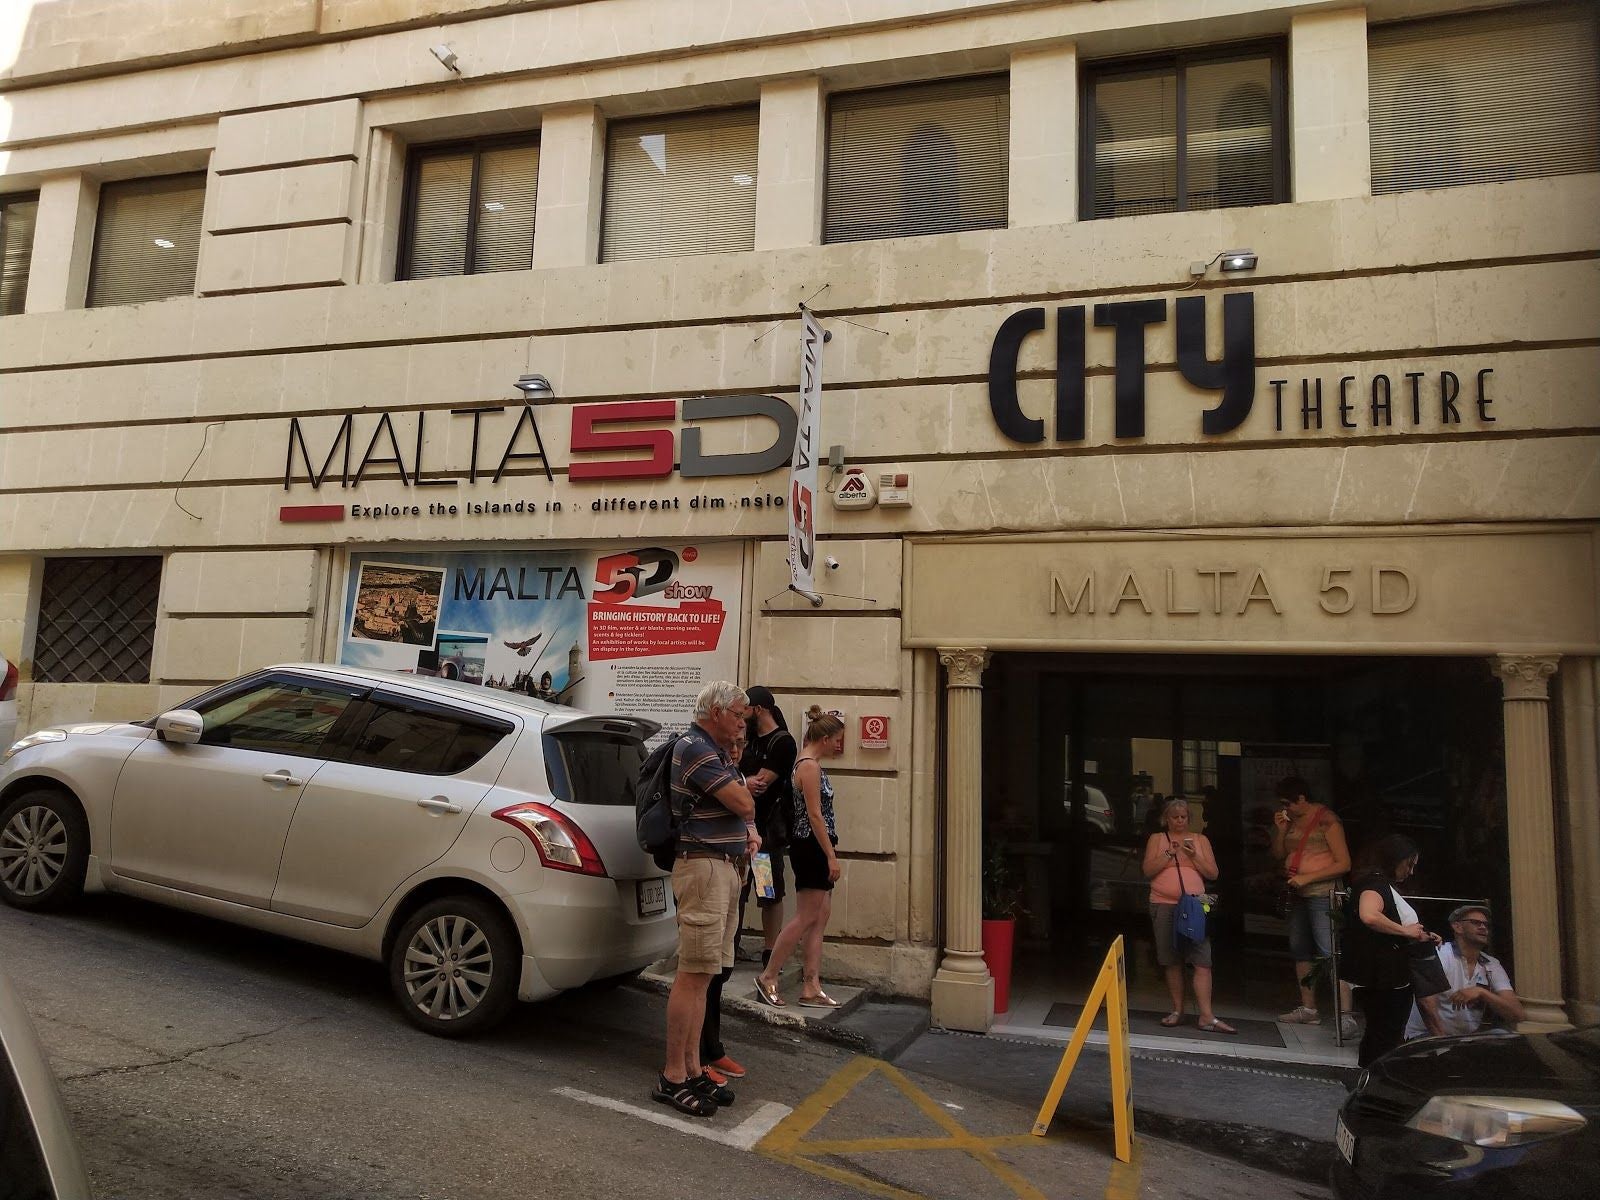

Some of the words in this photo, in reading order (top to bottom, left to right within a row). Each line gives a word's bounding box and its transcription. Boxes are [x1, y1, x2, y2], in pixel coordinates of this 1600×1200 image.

[989, 291, 1255, 443] CITY
[1269, 368, 1496, 431] THEATRE
[284, 406, 553, 490] MALTA
[569, 394, 798, 482] 5D
[351, 504, 419, 518] Explore
[429, 502, 457, 515] the
[467, 501, 536, 514] Islands
[546, 500, 561, 512] in
[591, 496, 680, 511] different
[839, 491, 867, 499] alberta
[454, 566, 586, 601] MALTA
[592, 547, 679, 603] 5D
[664, 581, 713, 600] show
[1048, 566, 1283, 616] MALTA
[1319, 566, 1418, 616] 5D
[592, 611, 631, 621] BRINGING
[632, 612, 667, 622] HISTORY
[667, 613, 688, 623] BACK
[689, 613, 700, 623] TO
[701, 614, 720, 624] LIFE!
